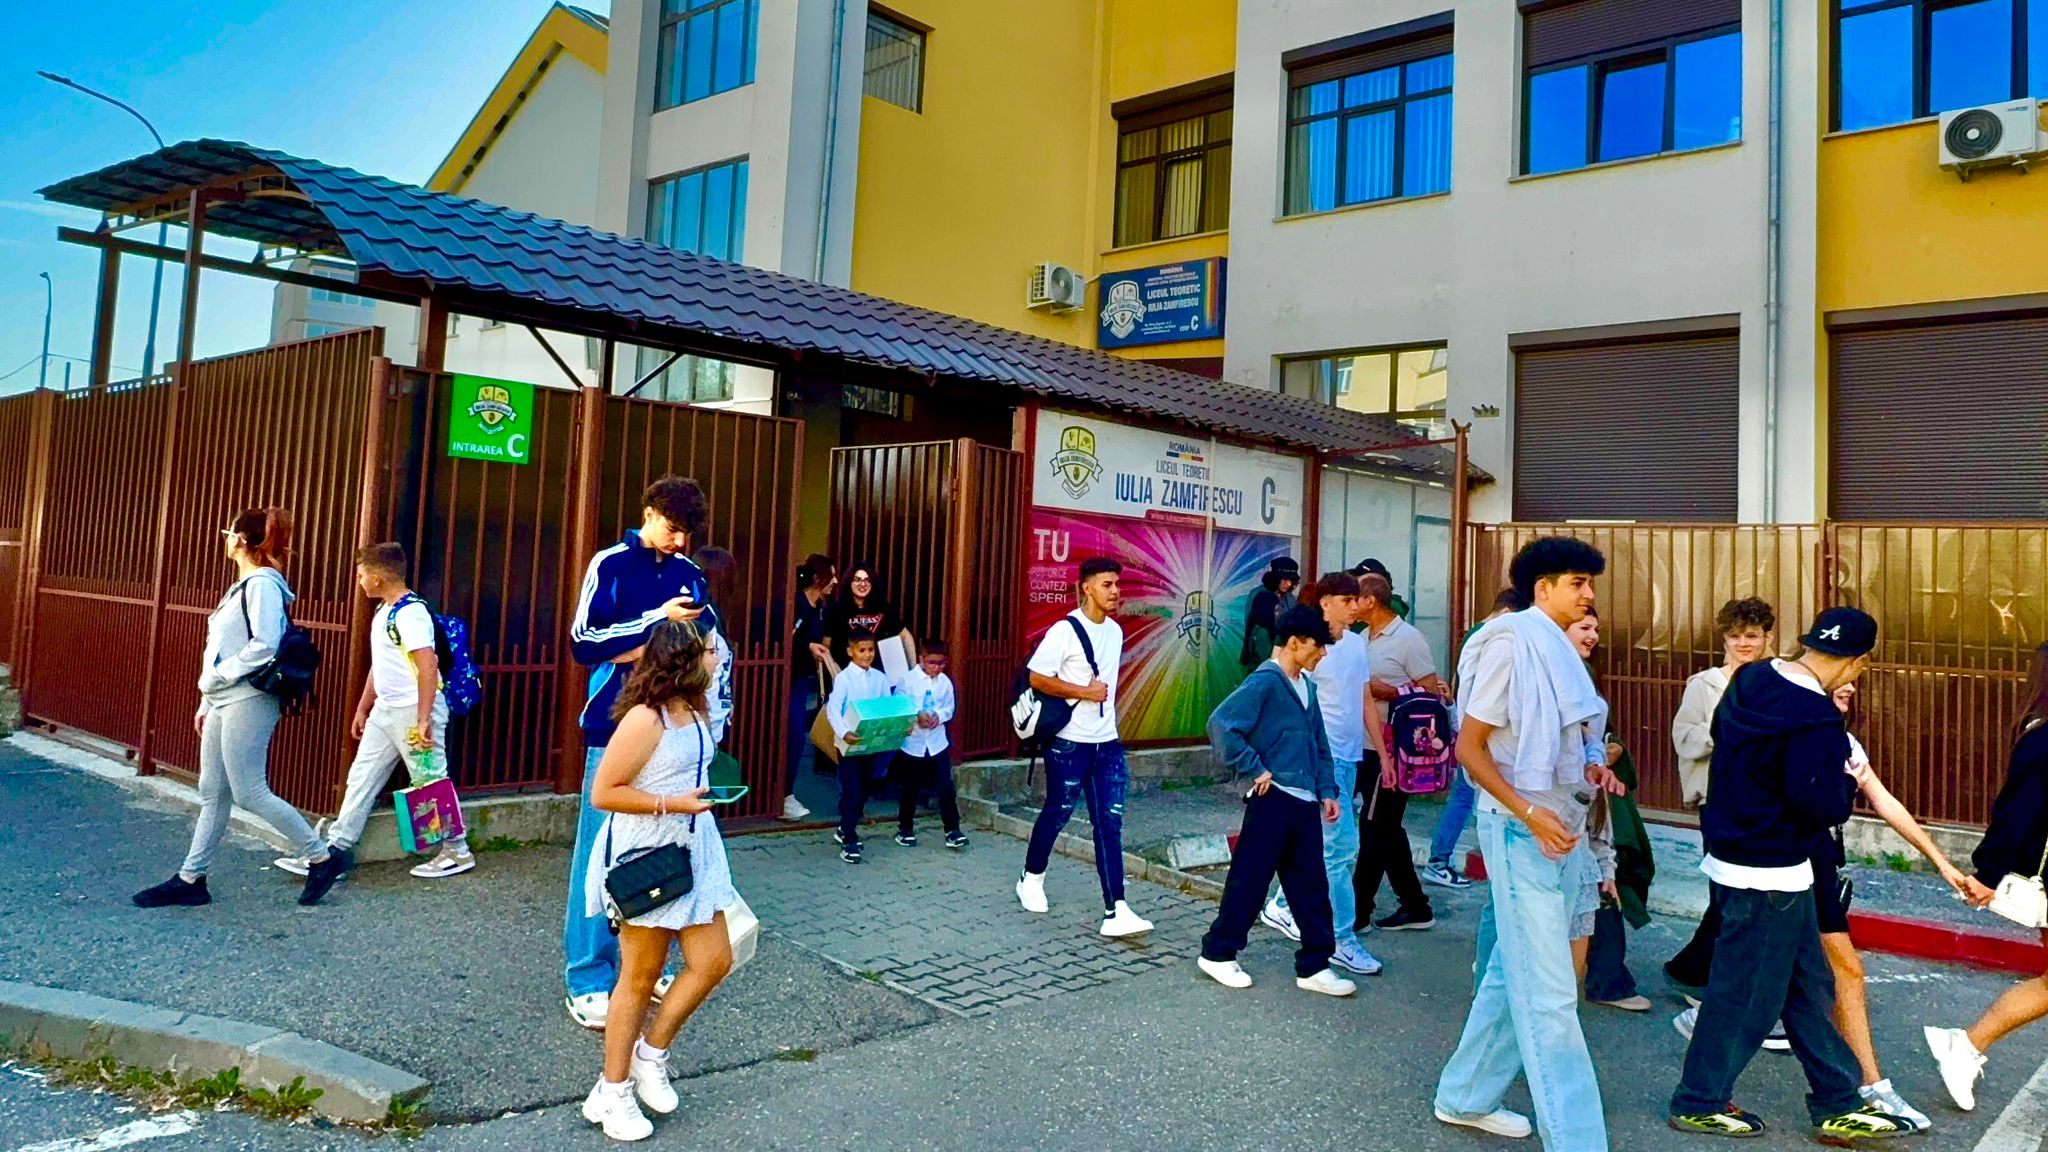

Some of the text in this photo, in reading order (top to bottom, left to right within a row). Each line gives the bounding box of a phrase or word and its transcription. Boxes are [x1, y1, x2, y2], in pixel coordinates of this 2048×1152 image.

[1147, 283, 1201, 300] LICEUL TEORETIC
[1191, 315, 1199, 331] C
[453, 433, 526, 458] INTRAREA C
[1169, 441, 1201, 454] ROMÂNIA
[1156, 459, 1179, 476] LICEUL
[1115, 472, 1153, 504] IULIA
[1261, 476, 1275, 525] C
[1033, 528, 1069, 562] TU
[1030, 580, 1067, 592] CONTEZI
[1029, 591, 1067, 604] SPERI
